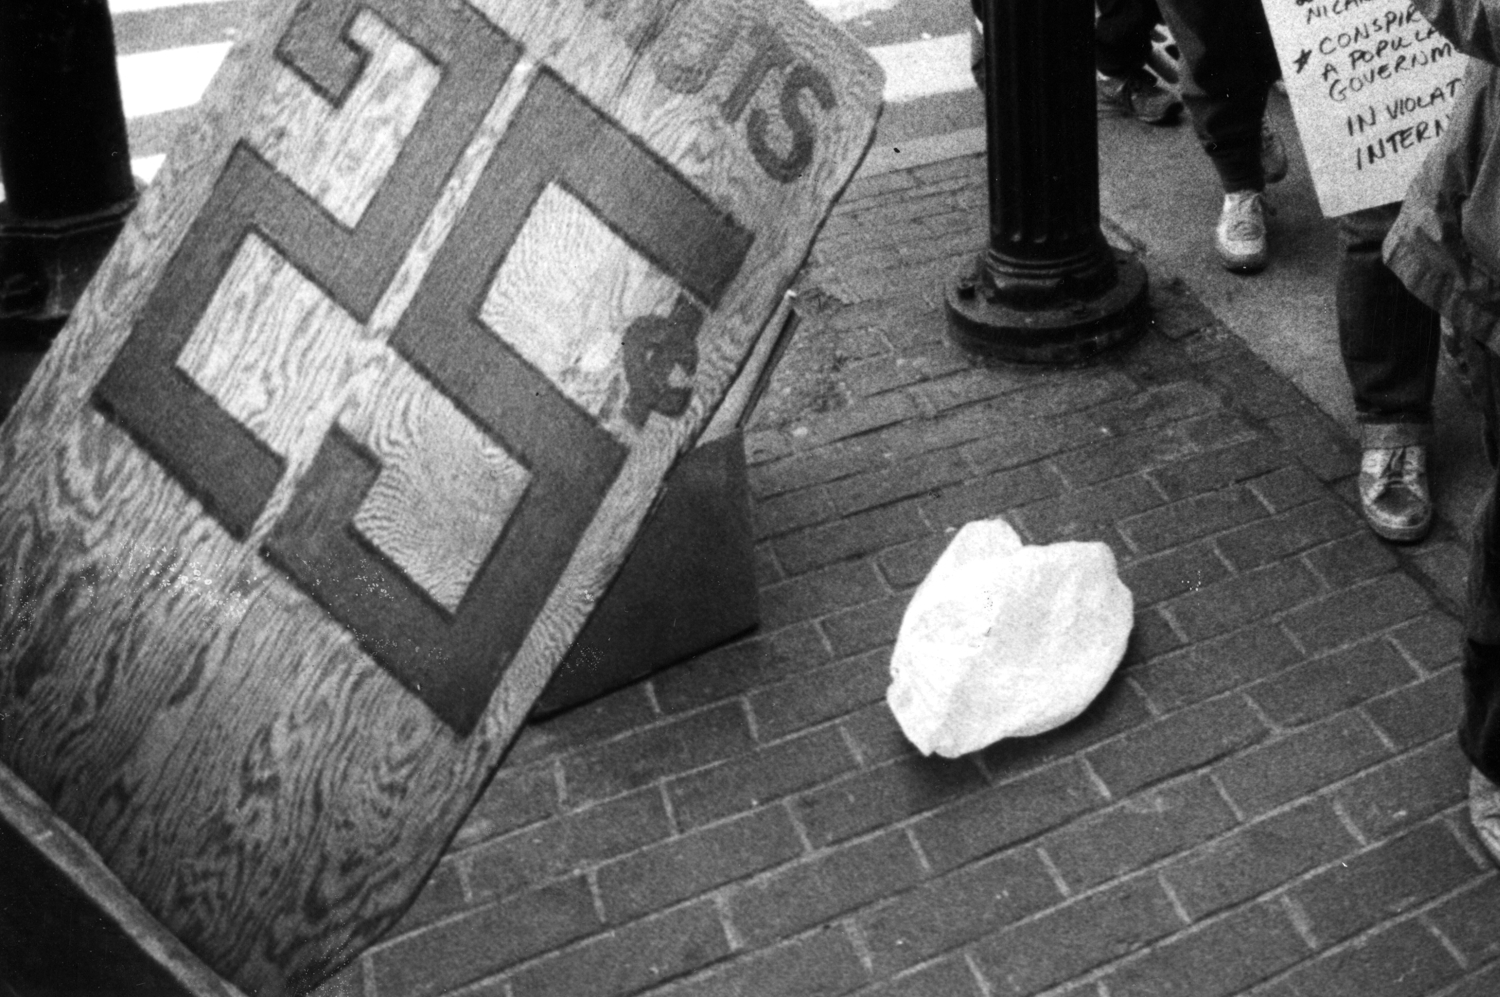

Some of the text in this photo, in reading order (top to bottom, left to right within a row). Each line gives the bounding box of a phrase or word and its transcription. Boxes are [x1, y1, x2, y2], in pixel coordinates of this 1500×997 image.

[1322, 63, 1339, 82] A
[1347, 78, 1462, 137] IN VIOLAT
